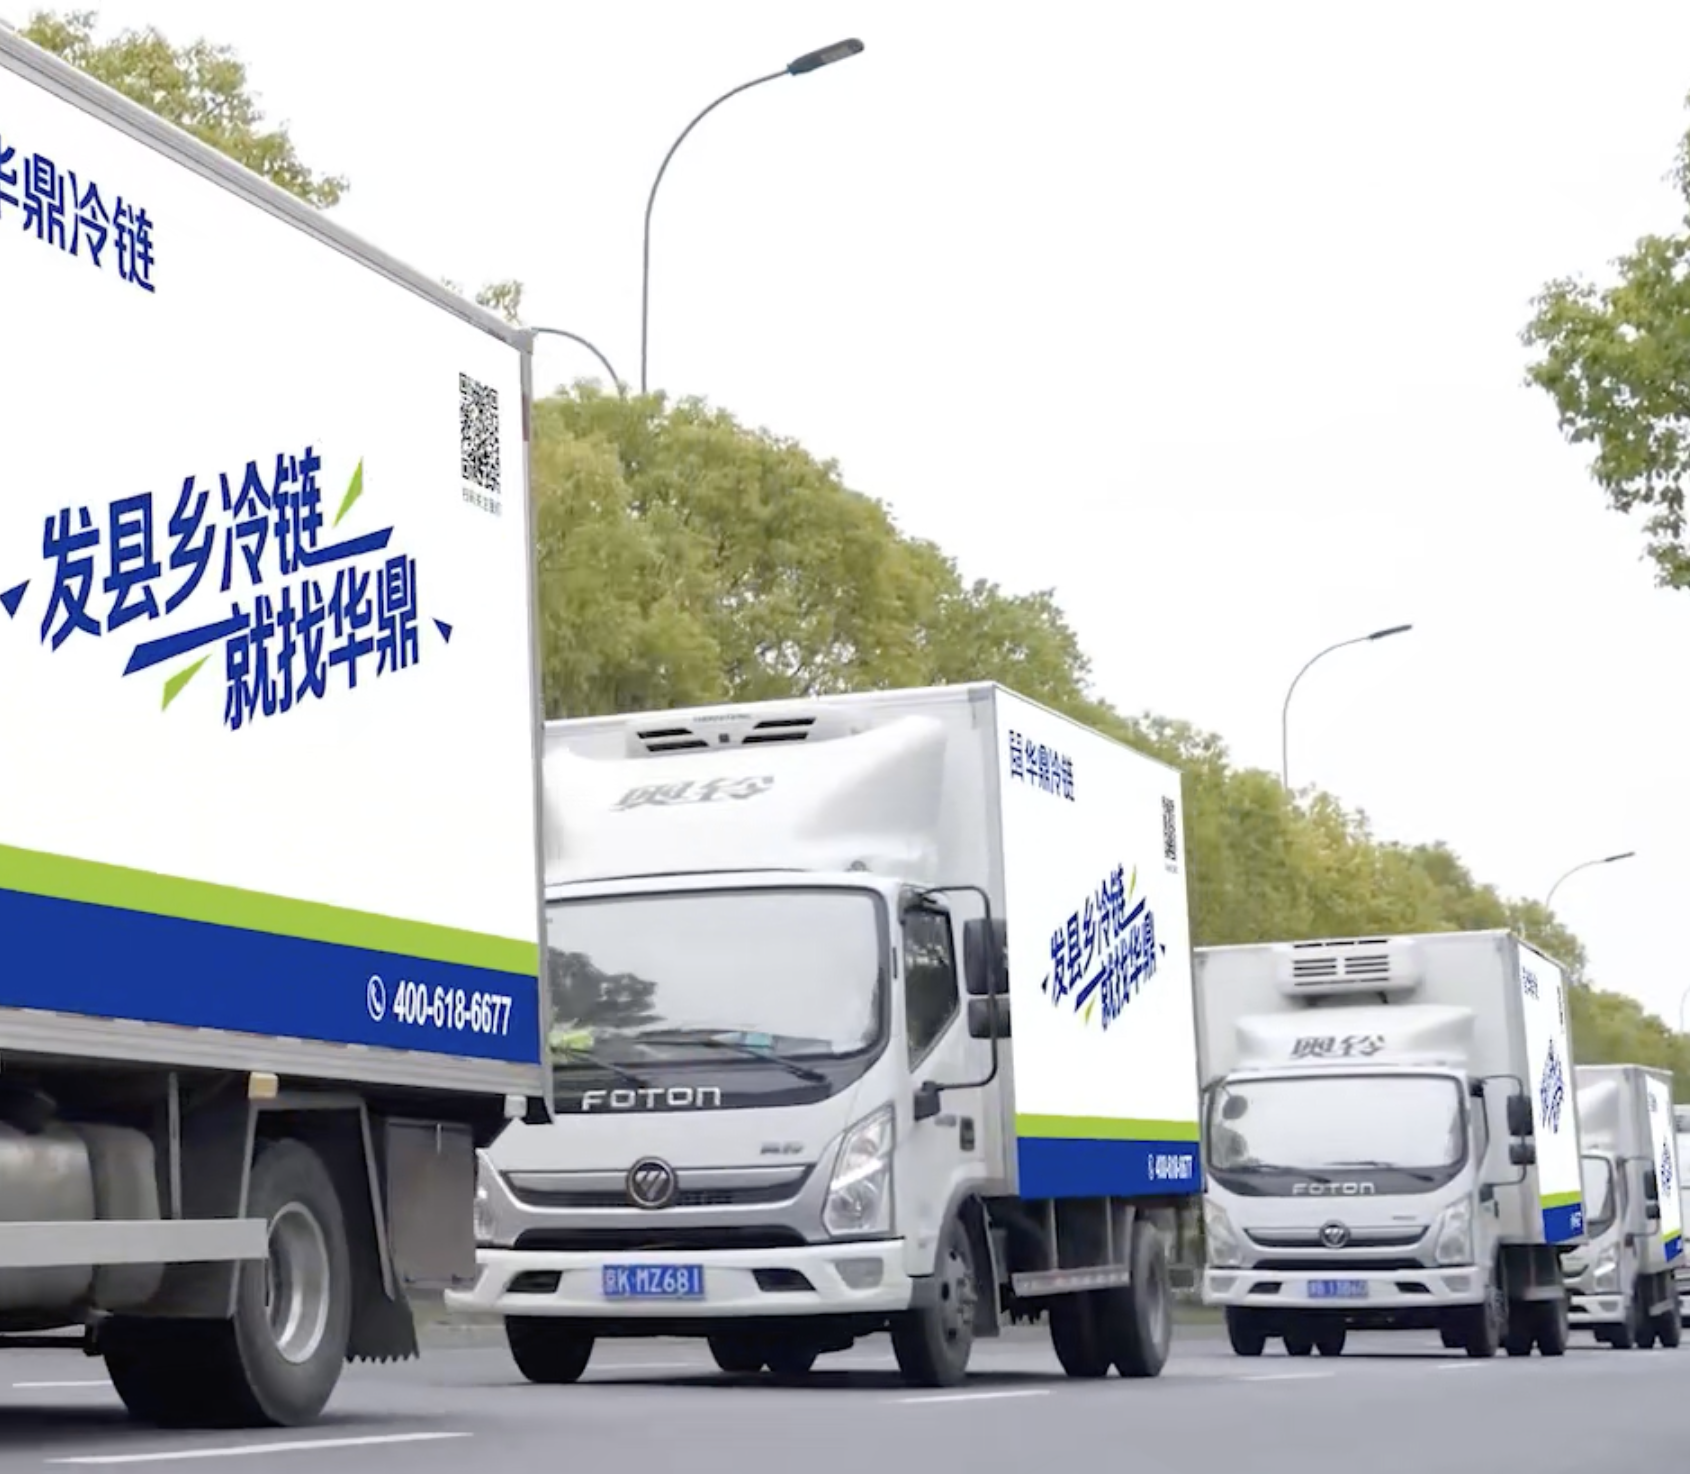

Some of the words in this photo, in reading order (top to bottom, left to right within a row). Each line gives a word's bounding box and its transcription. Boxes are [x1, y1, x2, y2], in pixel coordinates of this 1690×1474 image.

[40, 445, 395, 652] 发县乡冷链
[121, 553, 420, 731] 就找华鼎
[393, 979, 512, 1037] 400-618-6677
[582, 1087, 721, 1111] FOTON
[1292, 1182, 1376, 1196] FOTON
